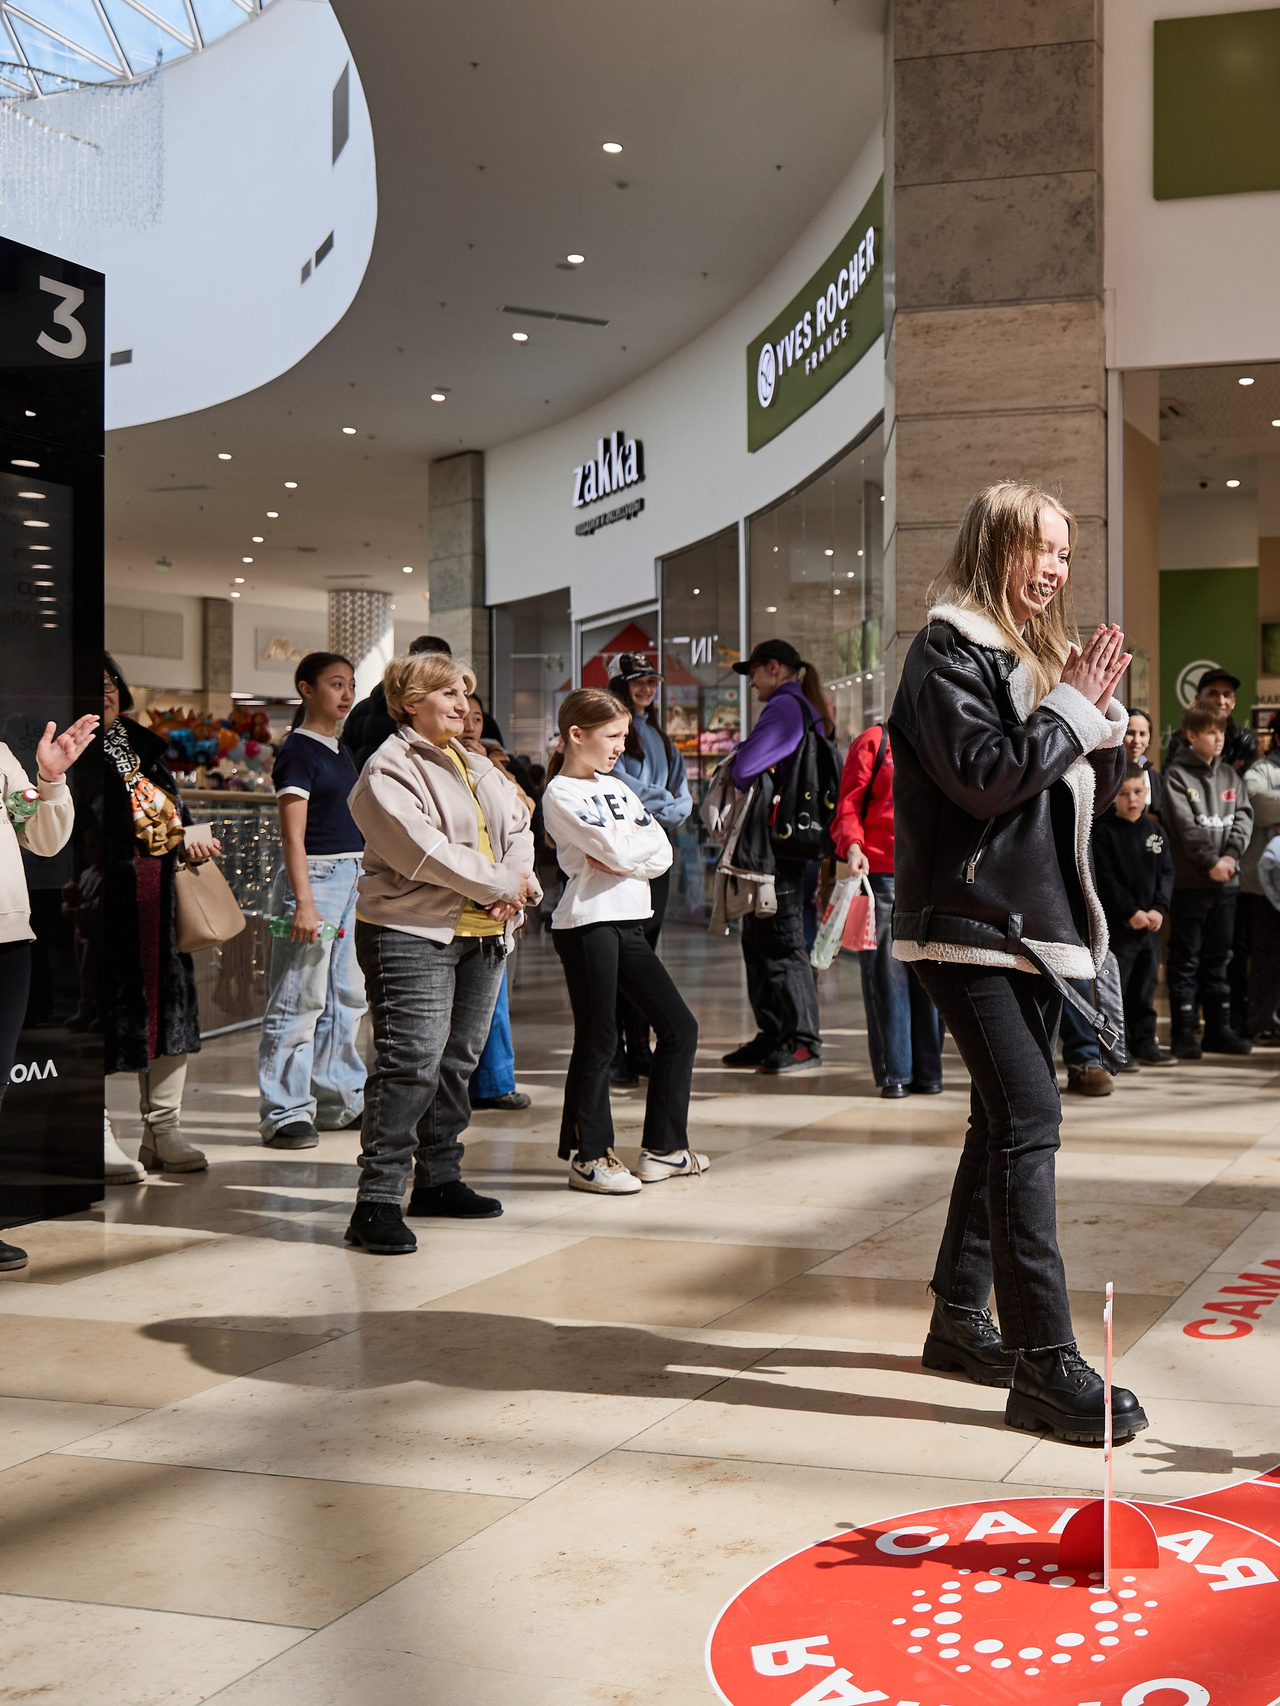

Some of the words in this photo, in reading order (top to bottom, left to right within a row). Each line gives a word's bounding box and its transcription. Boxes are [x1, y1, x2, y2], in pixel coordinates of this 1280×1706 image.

[36, 274, 87, 360] 3
[775, 311, 812, 376] YVES
[816, 225, 875, 337] ROCHER
[804, 318, 848, 376] FRANCE
[571, 430, 643, 508] zakka
[8, 1058, 59, 1084] ОЛЛ
[874, 1509, 1280, 1593] СААЯ
